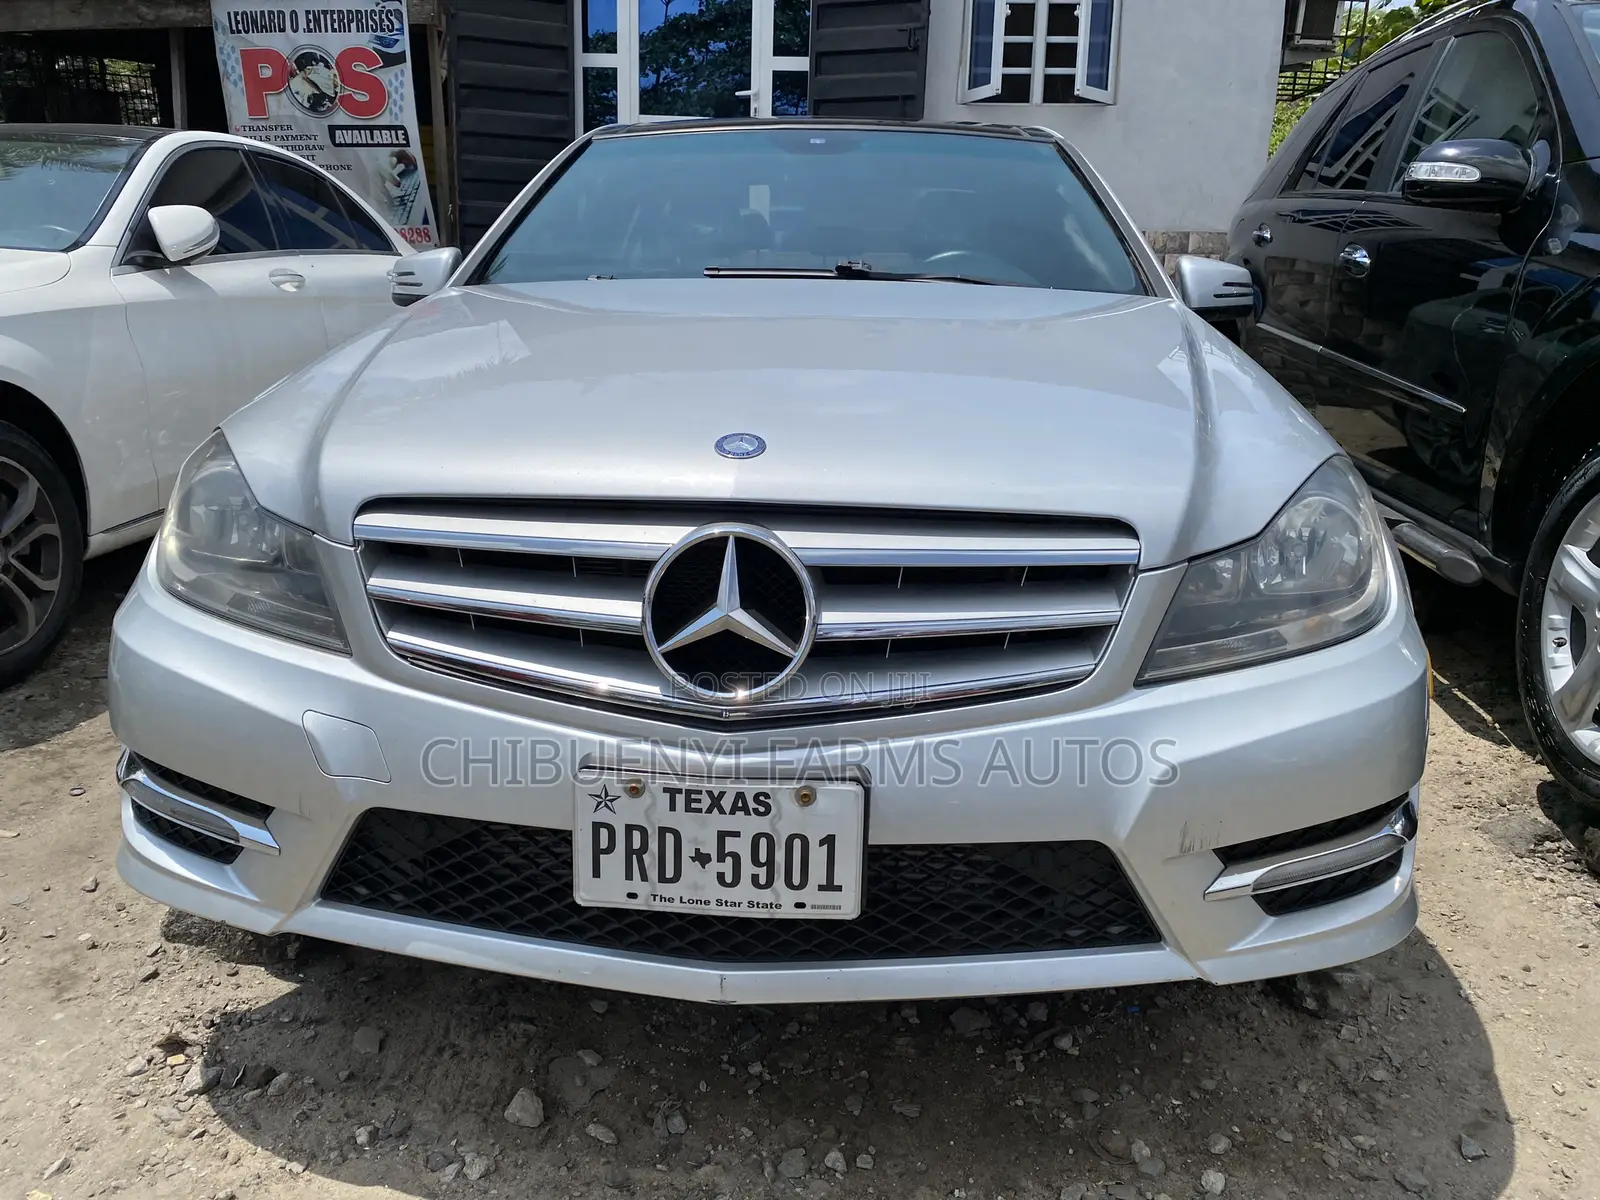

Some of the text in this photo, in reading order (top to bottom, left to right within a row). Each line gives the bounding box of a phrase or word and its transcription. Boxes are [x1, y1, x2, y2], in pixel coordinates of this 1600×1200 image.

[227, 10, 286, 34] LEONARD
[242, 124, 293, 132] TRANSFER
[335, 130, 407, 144] AVAILABLE
[663, 787, 772, 817] TEXAS
[591, 821, 843, 892] PRD 5901
[650, 893, 783, 911] The Lone Star State
